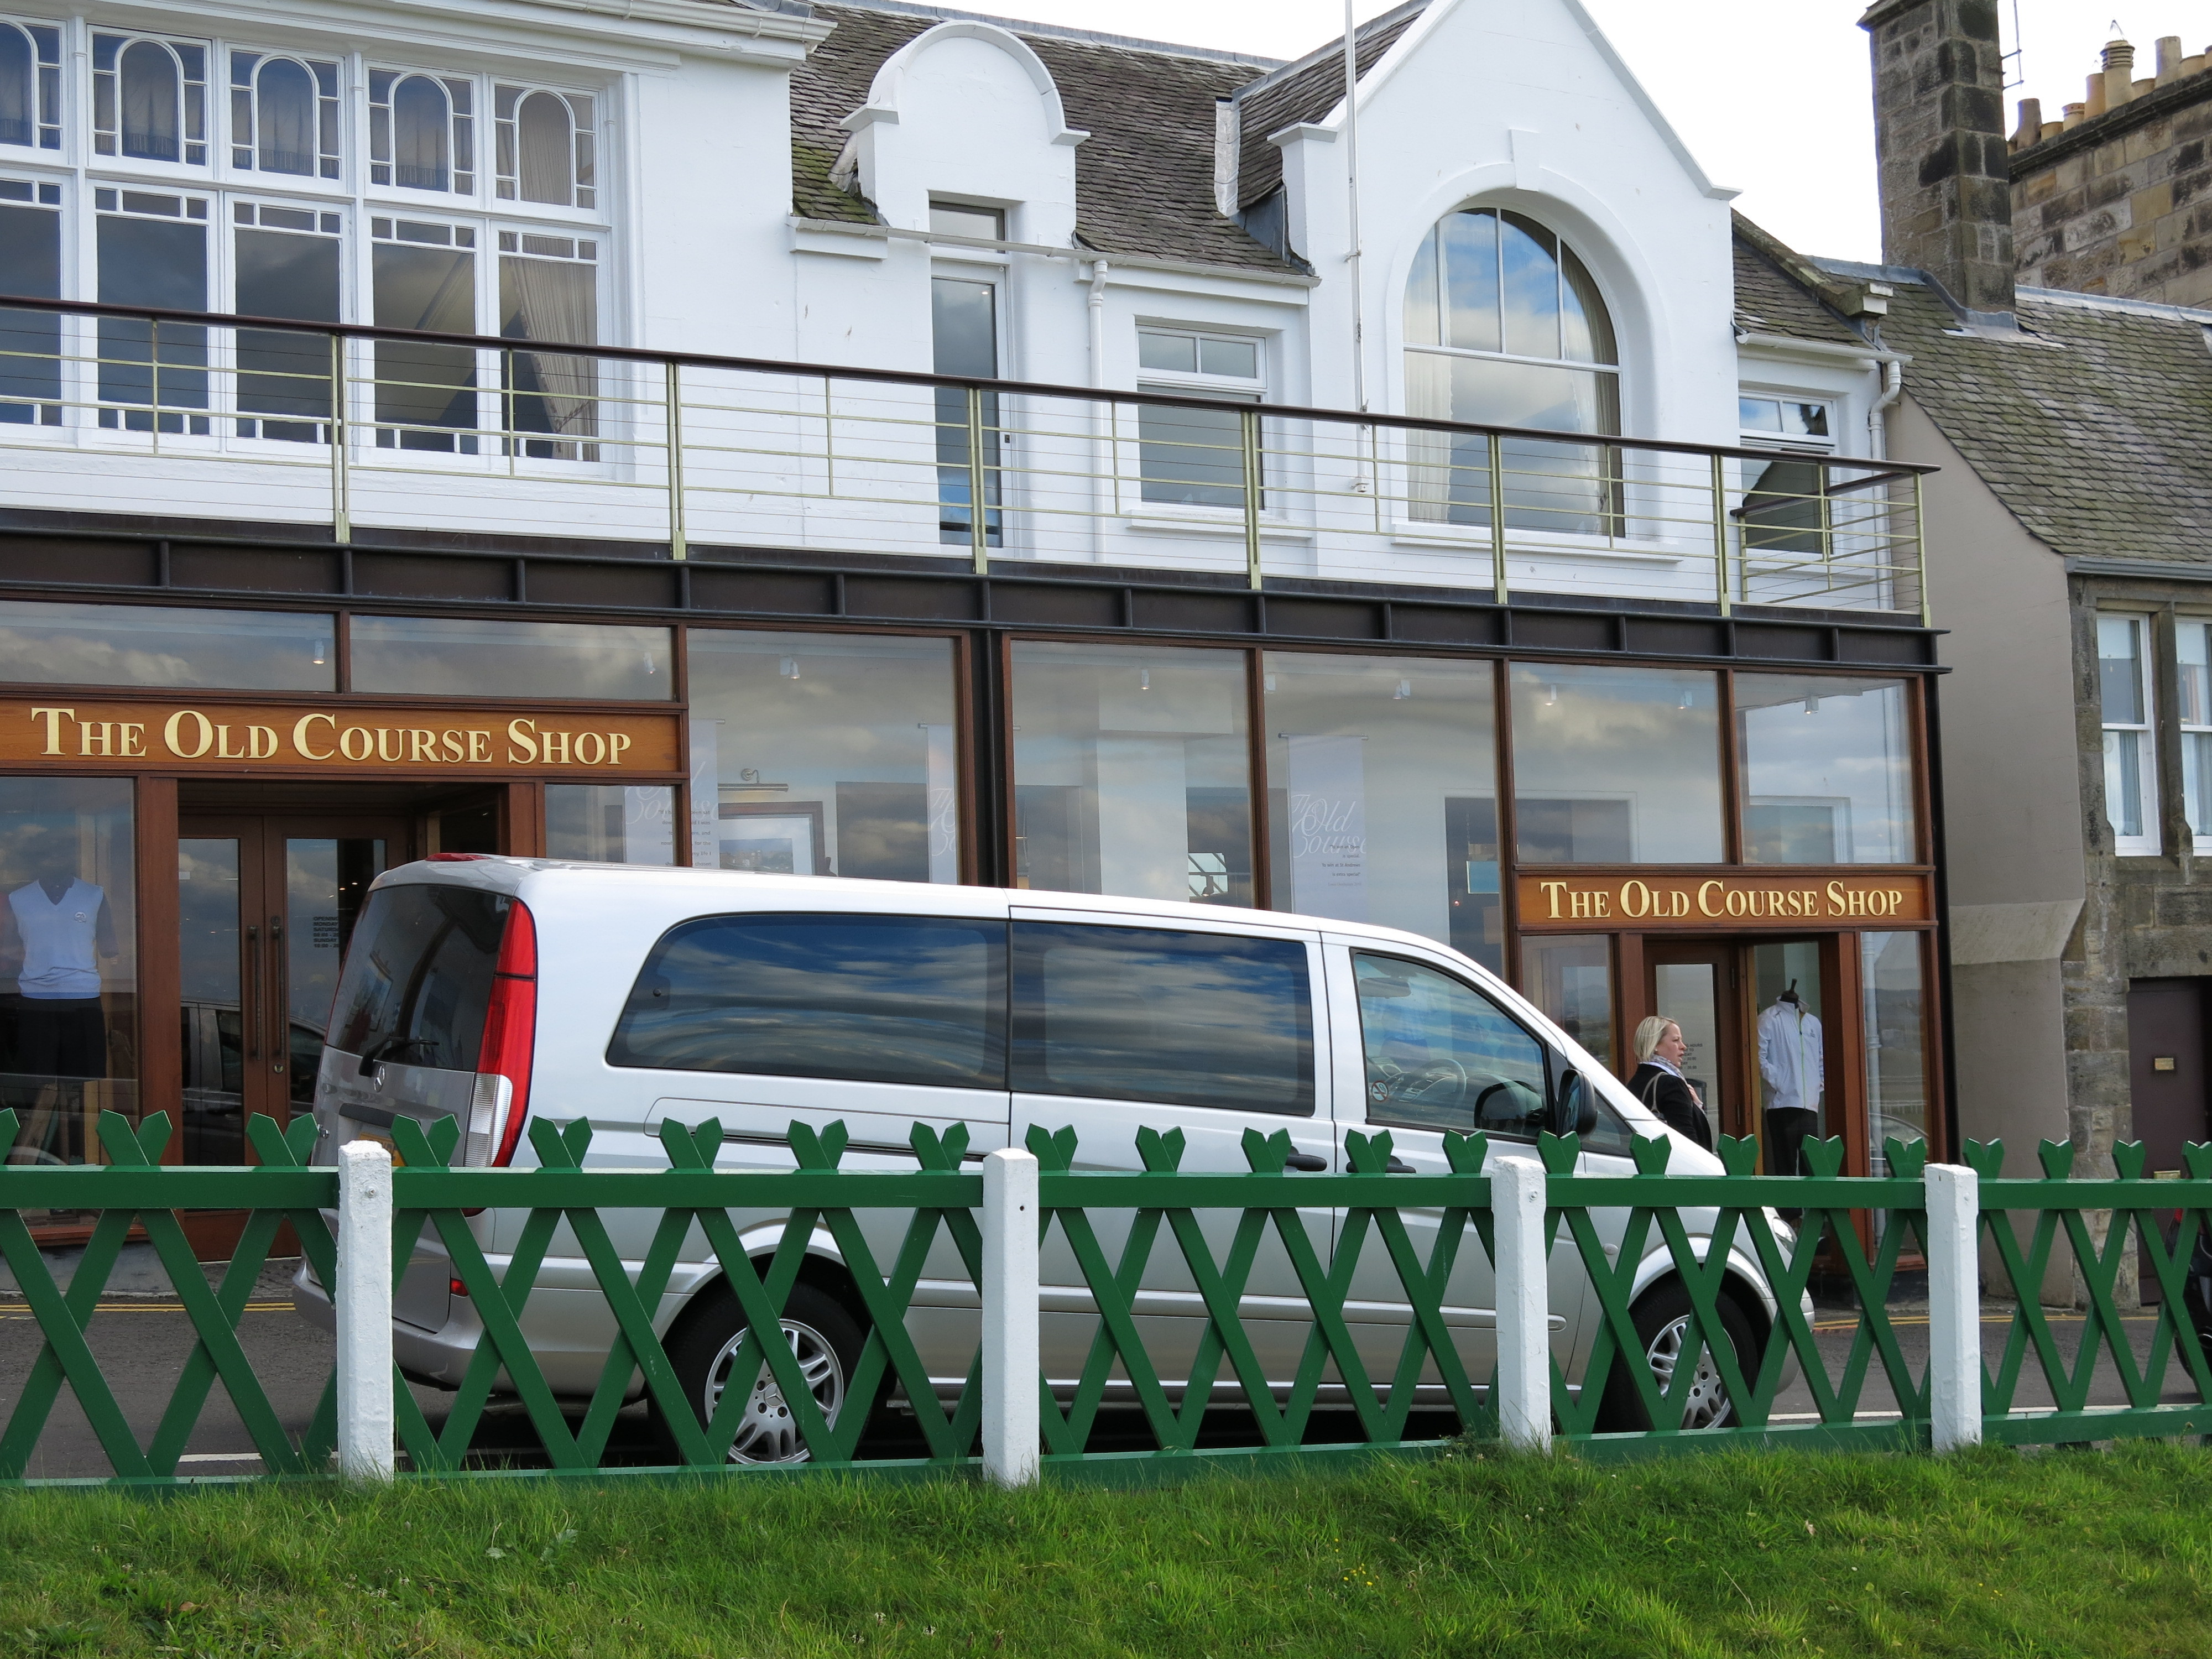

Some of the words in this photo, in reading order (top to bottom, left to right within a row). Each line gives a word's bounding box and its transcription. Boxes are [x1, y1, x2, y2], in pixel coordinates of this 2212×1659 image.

[31, 707, 147, 757] THE
[164, 710, 278, 759] OLD
[293, 713, 493, 763] COURSE
[508, 718, 631, 764] SHOP
[1540, 881, 1611, 919] THE
[1620, 880, 1689, 918] OLD
[1698, 880, 1819, 917] COURSE
[1827, 880, 1902, 917] SHOP
